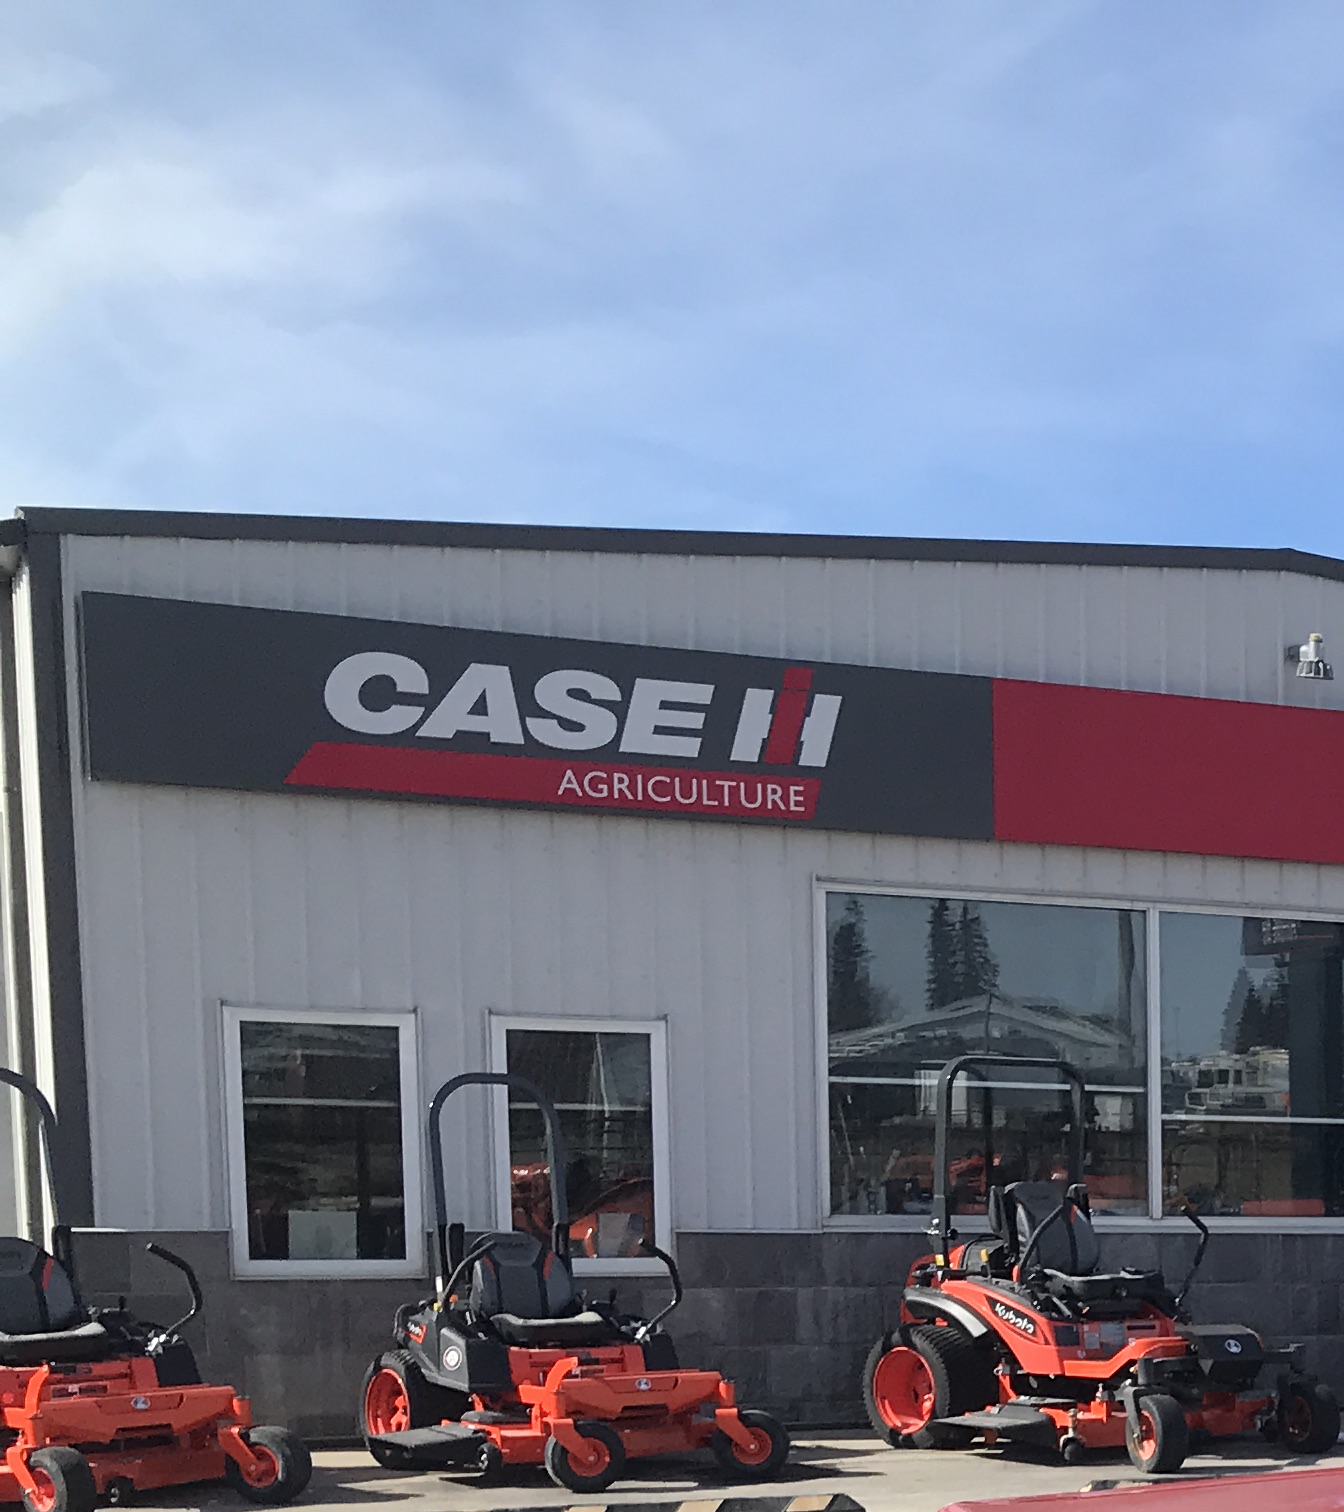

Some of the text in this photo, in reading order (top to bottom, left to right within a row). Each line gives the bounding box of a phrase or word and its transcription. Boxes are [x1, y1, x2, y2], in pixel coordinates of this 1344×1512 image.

[323, 650, 715, 758] CASE
[557, 768, 806, 812] AGRICULTURE
[994, 1302, 1035, 1335] Kubota
